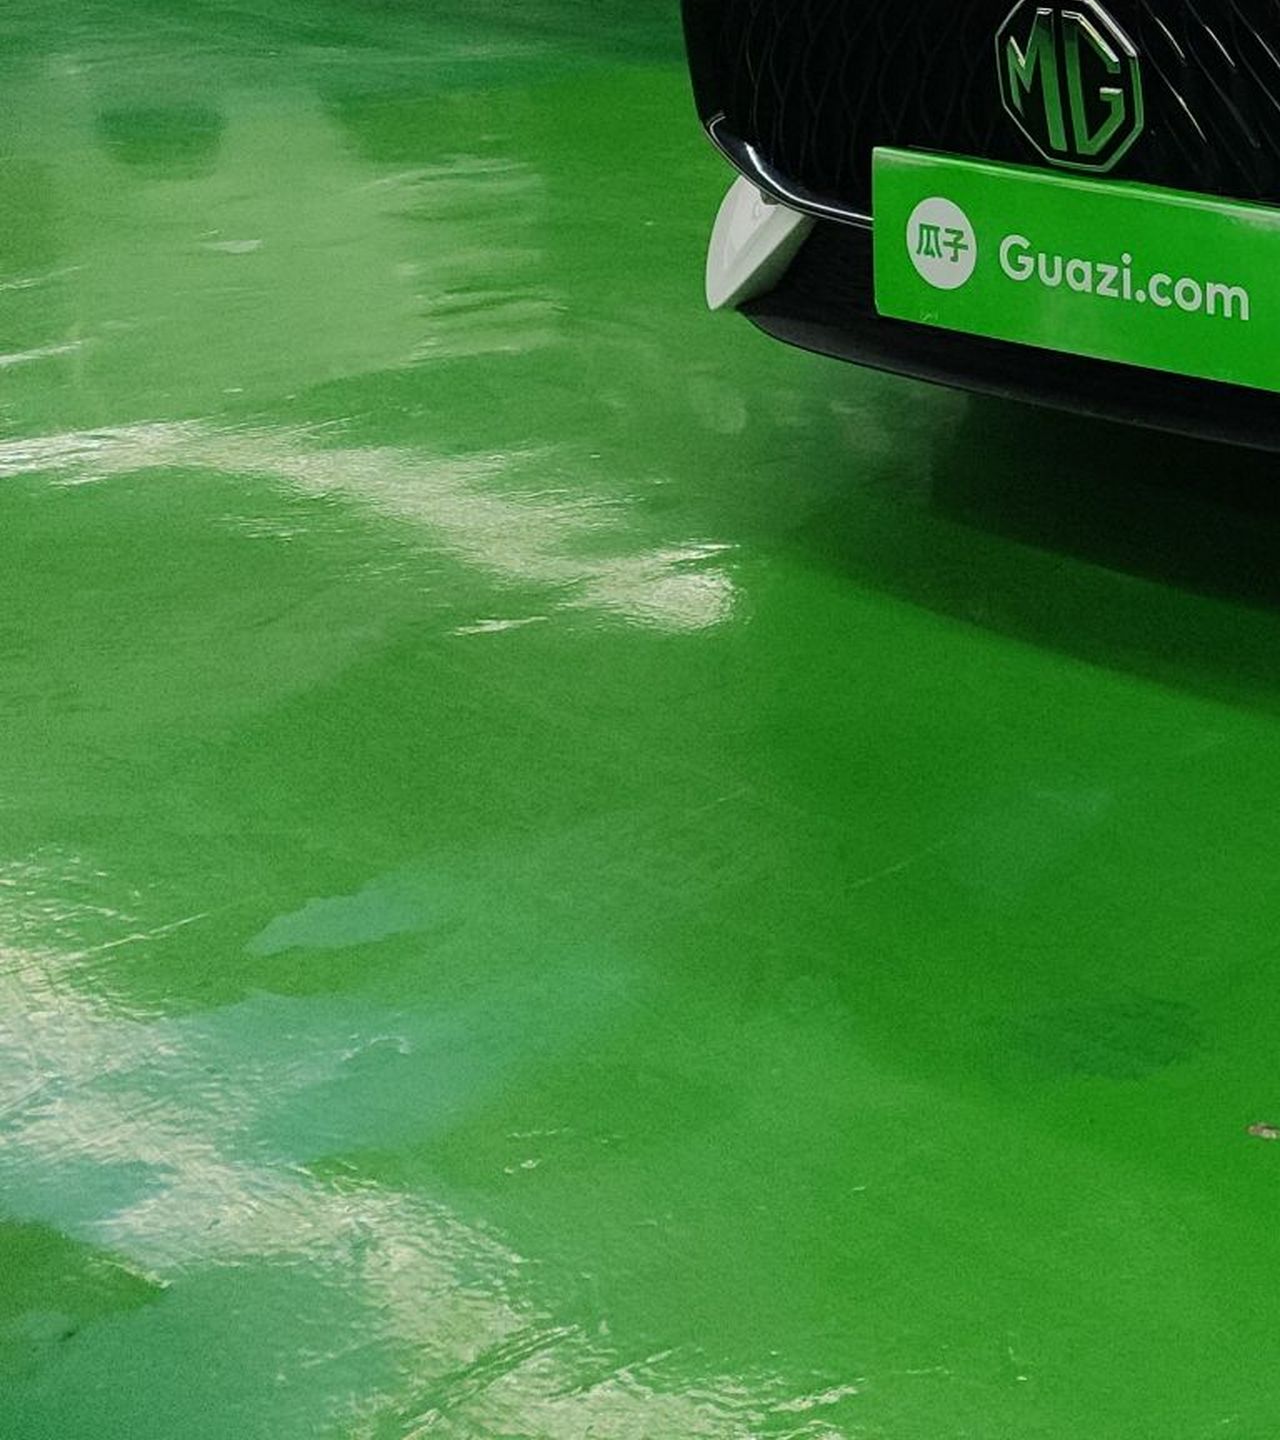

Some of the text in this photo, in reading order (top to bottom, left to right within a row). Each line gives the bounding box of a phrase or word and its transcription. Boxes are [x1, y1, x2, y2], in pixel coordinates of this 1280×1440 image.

[1005, 6, 1127, 157] MG
[915, 222, 1251, 322] 瓜子 Guazi.com
